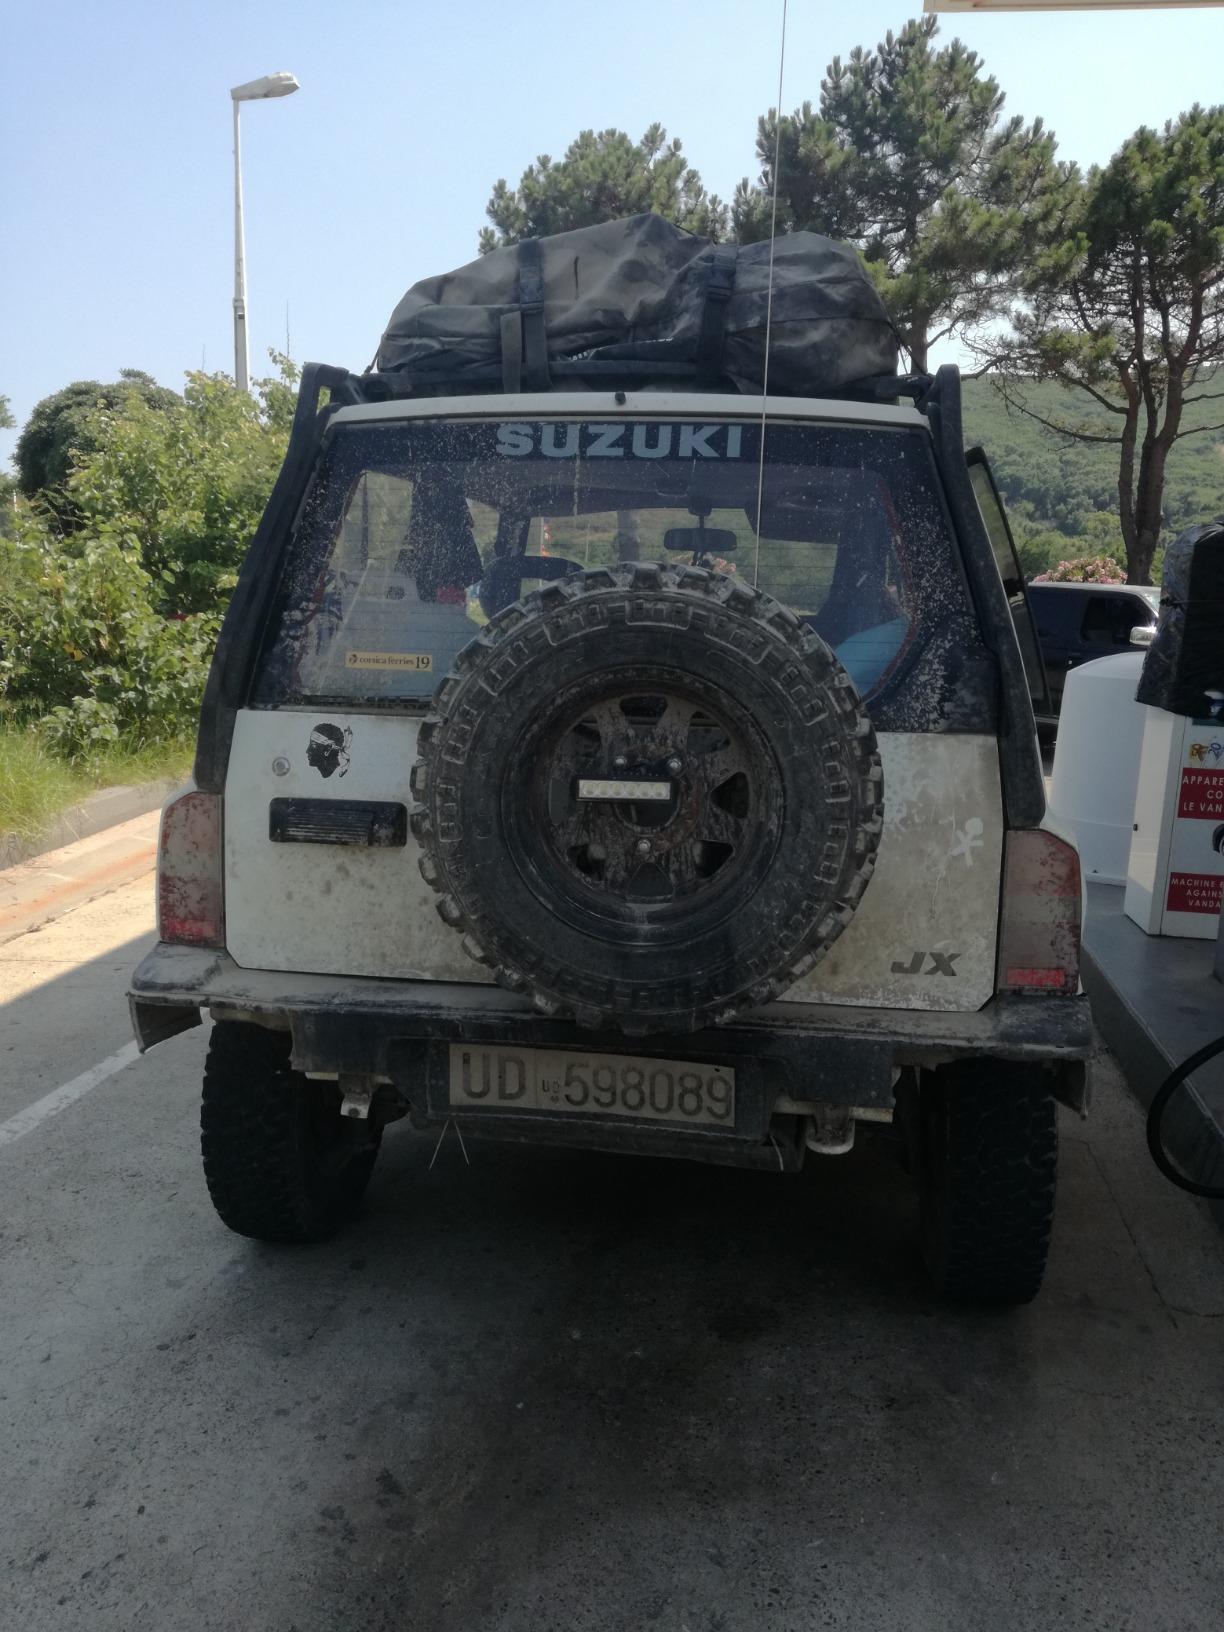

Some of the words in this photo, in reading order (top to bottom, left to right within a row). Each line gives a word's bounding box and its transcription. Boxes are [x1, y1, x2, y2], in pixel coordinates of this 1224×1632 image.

[496, 424, 742, 458] SUZUKI
[359, 655, 387, 665] corsica
[388, 656, 414, 665] ferries
[415, 656, 430, 669] 19
[1183, 802, 1195, 811] LE
[1171, 878, 1216, 888] MACHINE
[890, 951, 962, 977] JX
[462, 1052, 526, 1100] UD
[564, 1061, 733, 1120] 598089
